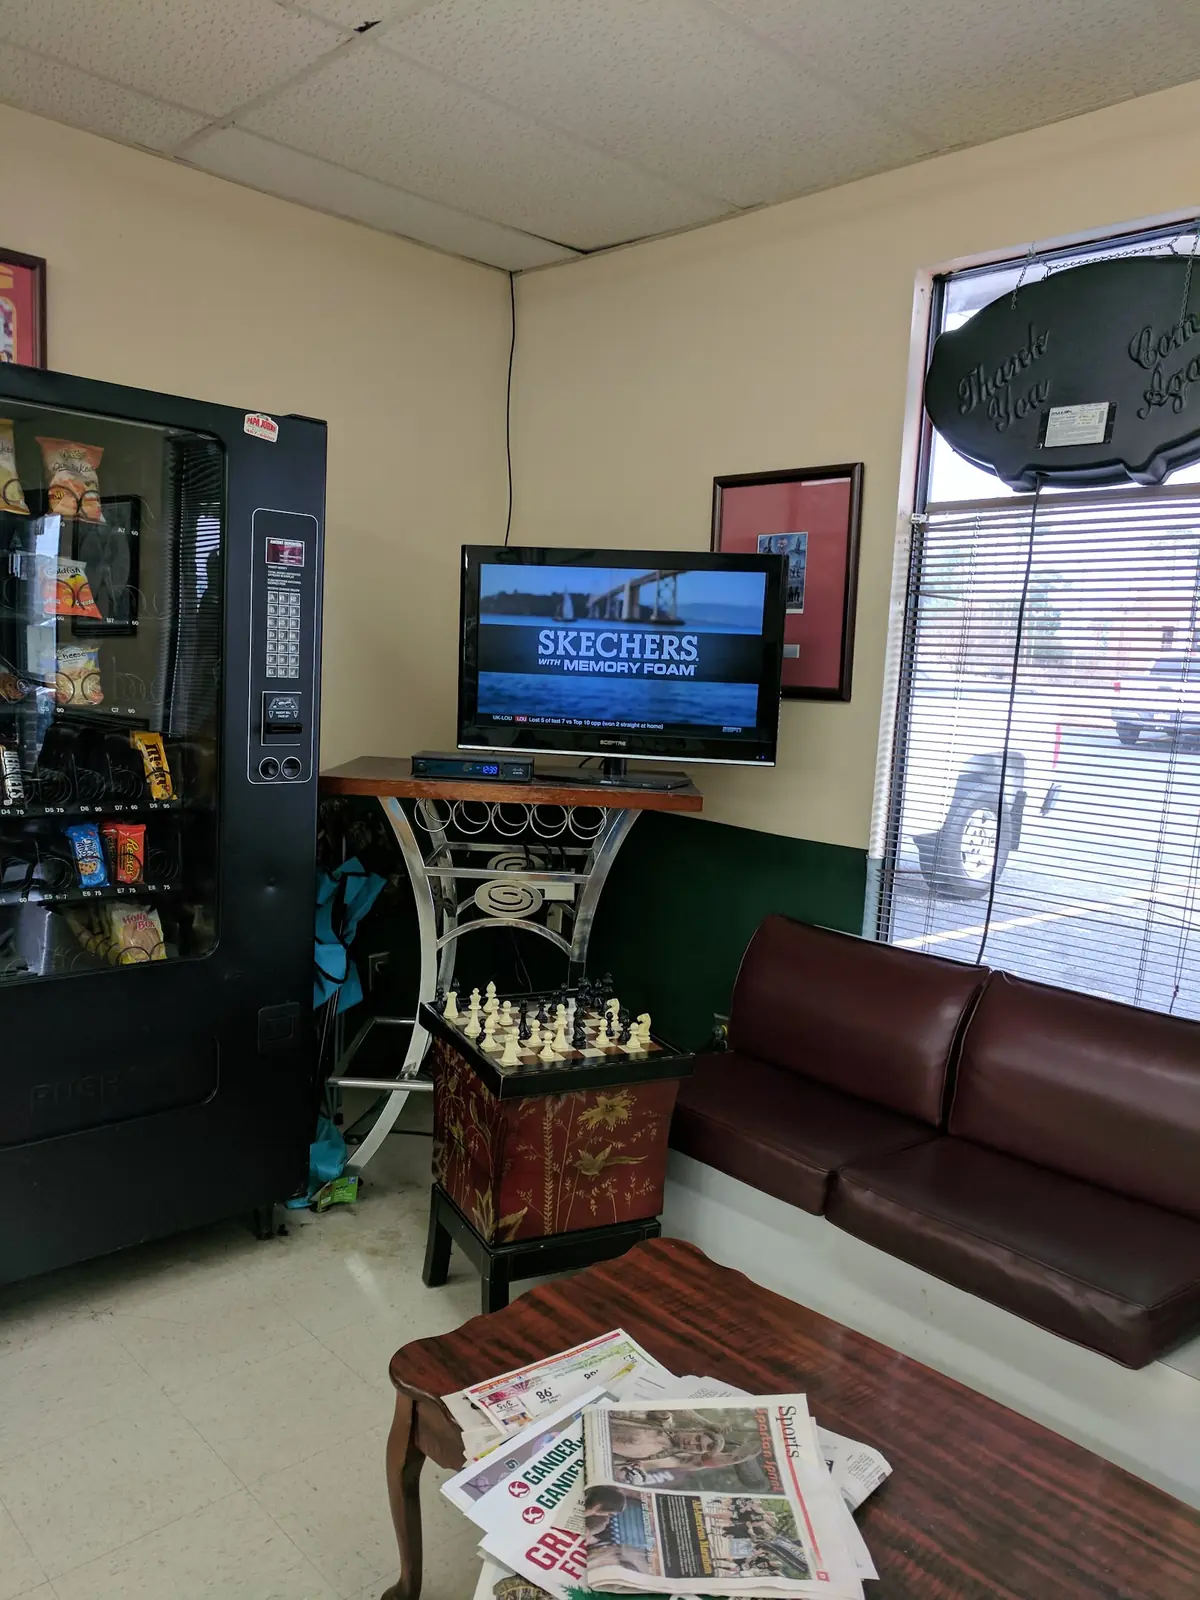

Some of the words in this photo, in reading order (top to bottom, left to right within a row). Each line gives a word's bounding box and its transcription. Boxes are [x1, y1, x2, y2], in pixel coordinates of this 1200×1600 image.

[1128, 313, 1200, 370] Com
[987, 379, 1050, 432] You
[1136, 360, 1200, 420] Aga
[246, 416, 261, 427] PAPA
[538, 629, 699, 662] SKECHERS
[538, 658, 561, 667] WITH
[563, 659, 640, 674] MEMORY
[643, 663, 695, 676] FOAM
[776, 1405, 802, 1459] Sports
[522, 1438, 576, 1486] GANDER
